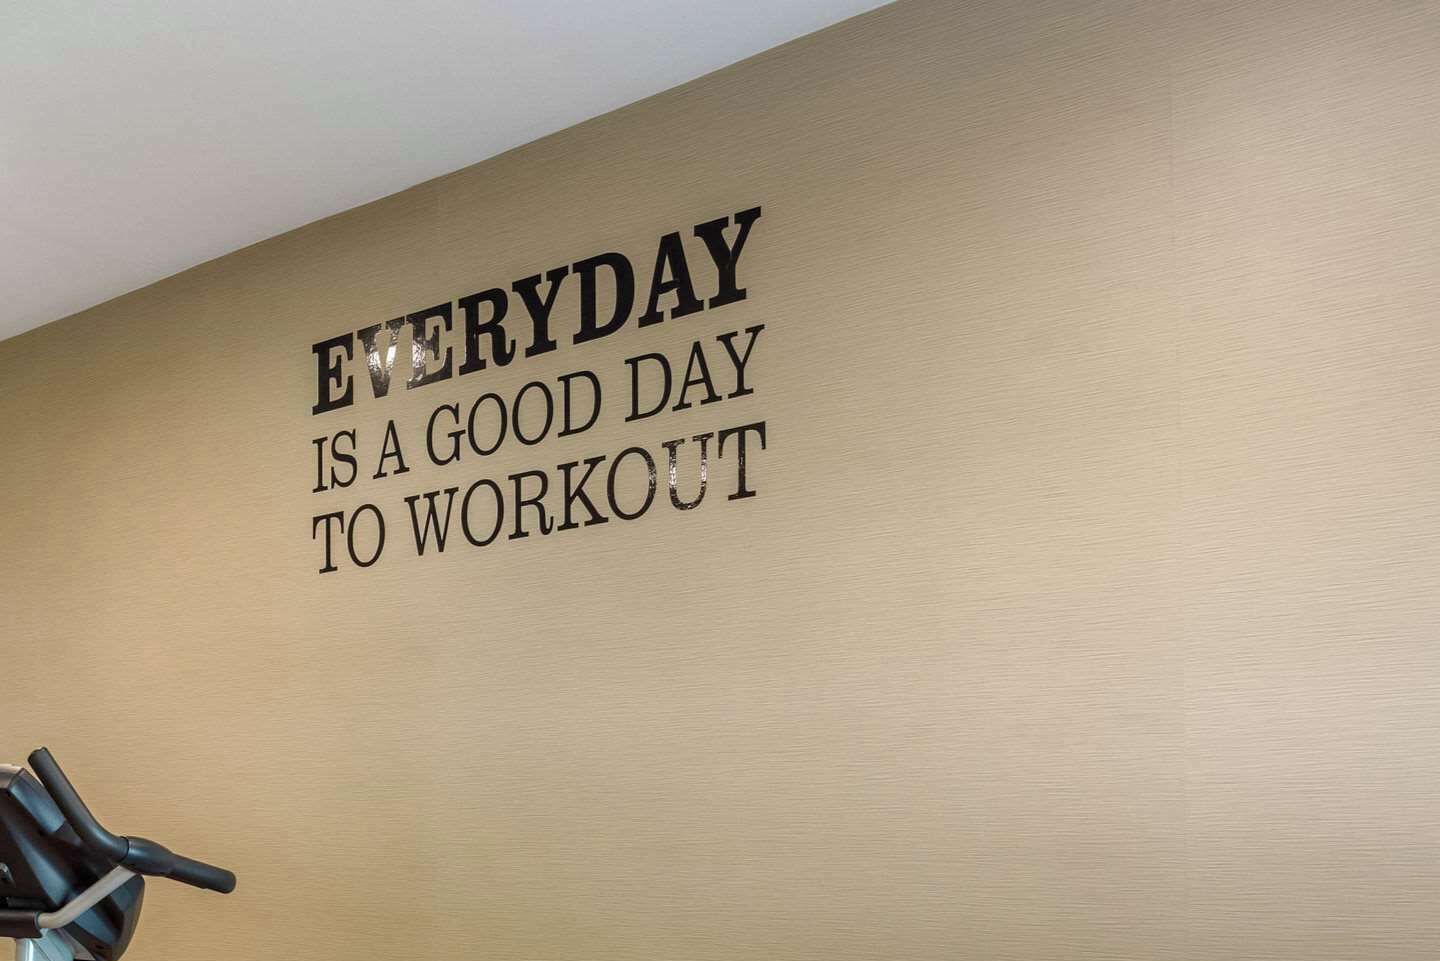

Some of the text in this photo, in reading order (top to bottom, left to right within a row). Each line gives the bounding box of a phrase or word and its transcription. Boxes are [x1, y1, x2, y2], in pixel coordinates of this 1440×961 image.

[312, 206, 762, 416] EVERYDAY
[312, 324, 765, 493] IS A GOOD DAY
[312, 421, 766, 574] TO WORKOUT
